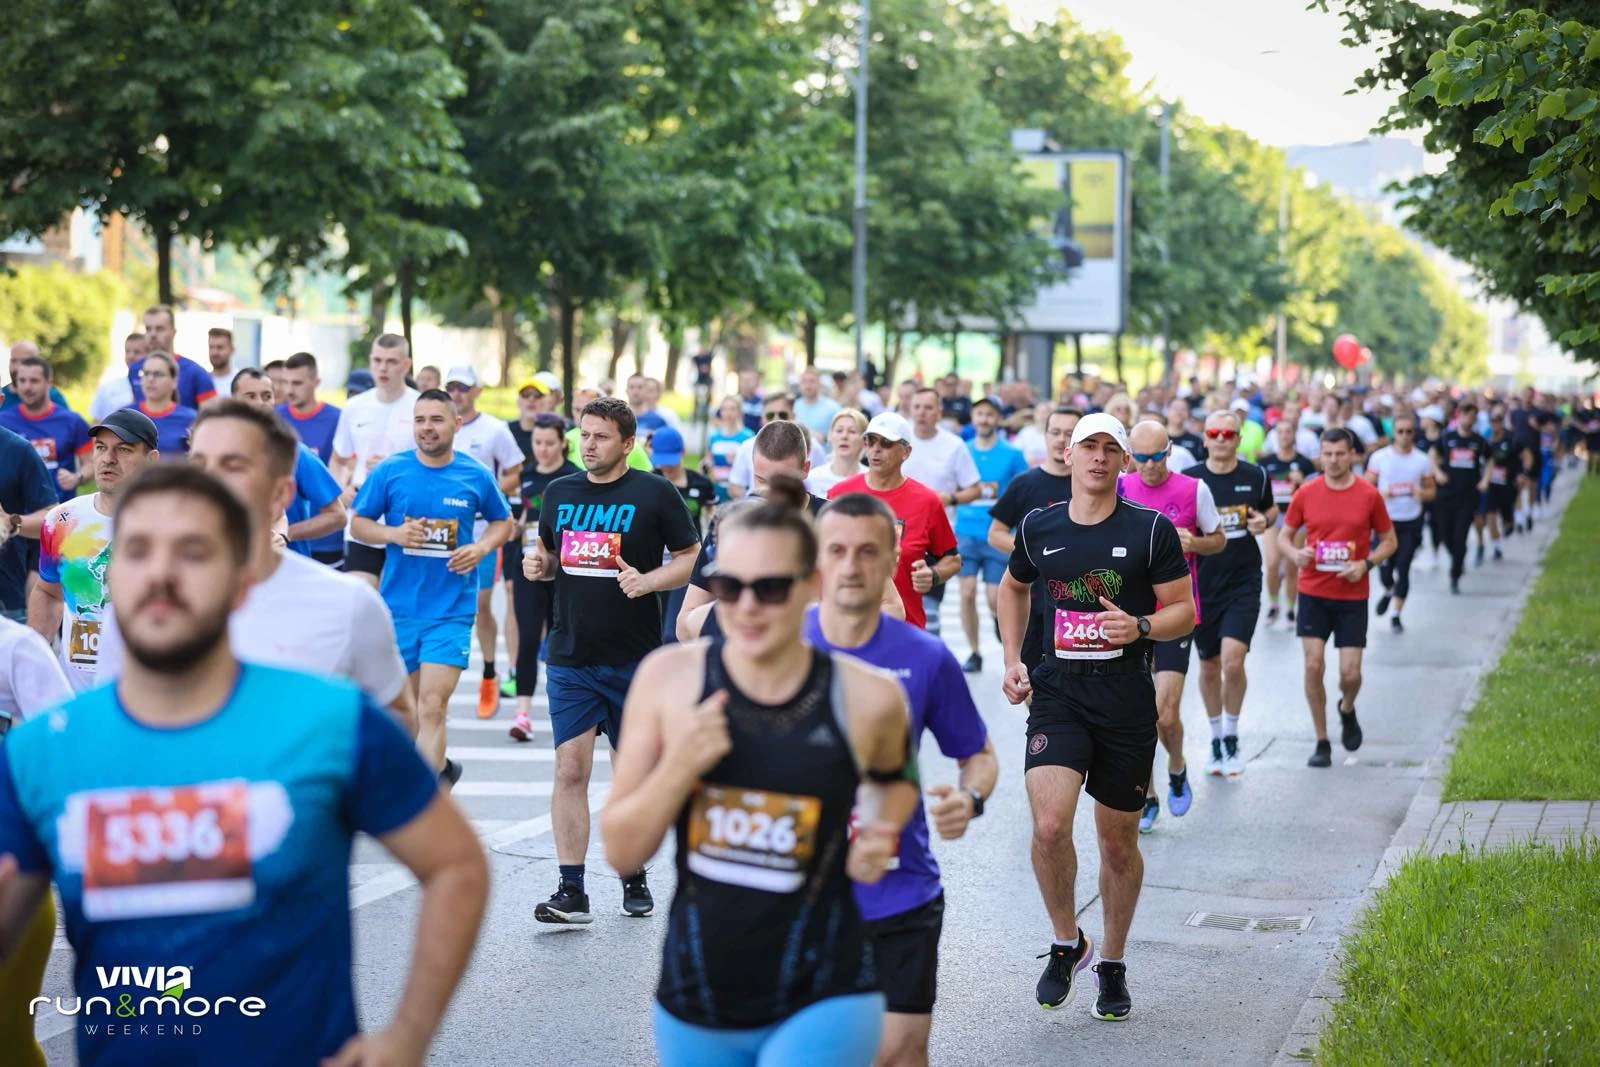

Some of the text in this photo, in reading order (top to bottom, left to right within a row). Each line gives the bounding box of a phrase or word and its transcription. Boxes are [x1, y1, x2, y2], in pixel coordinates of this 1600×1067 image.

[555, 503, 636, 533] PUMA
[423, 526, 449, 542] 041
[569, 540, 611, 559] 2434
[80, 632, 99, 652] 10
[104, 807, 225, 865] 5336
[705, 804, 797, 854] 1026
